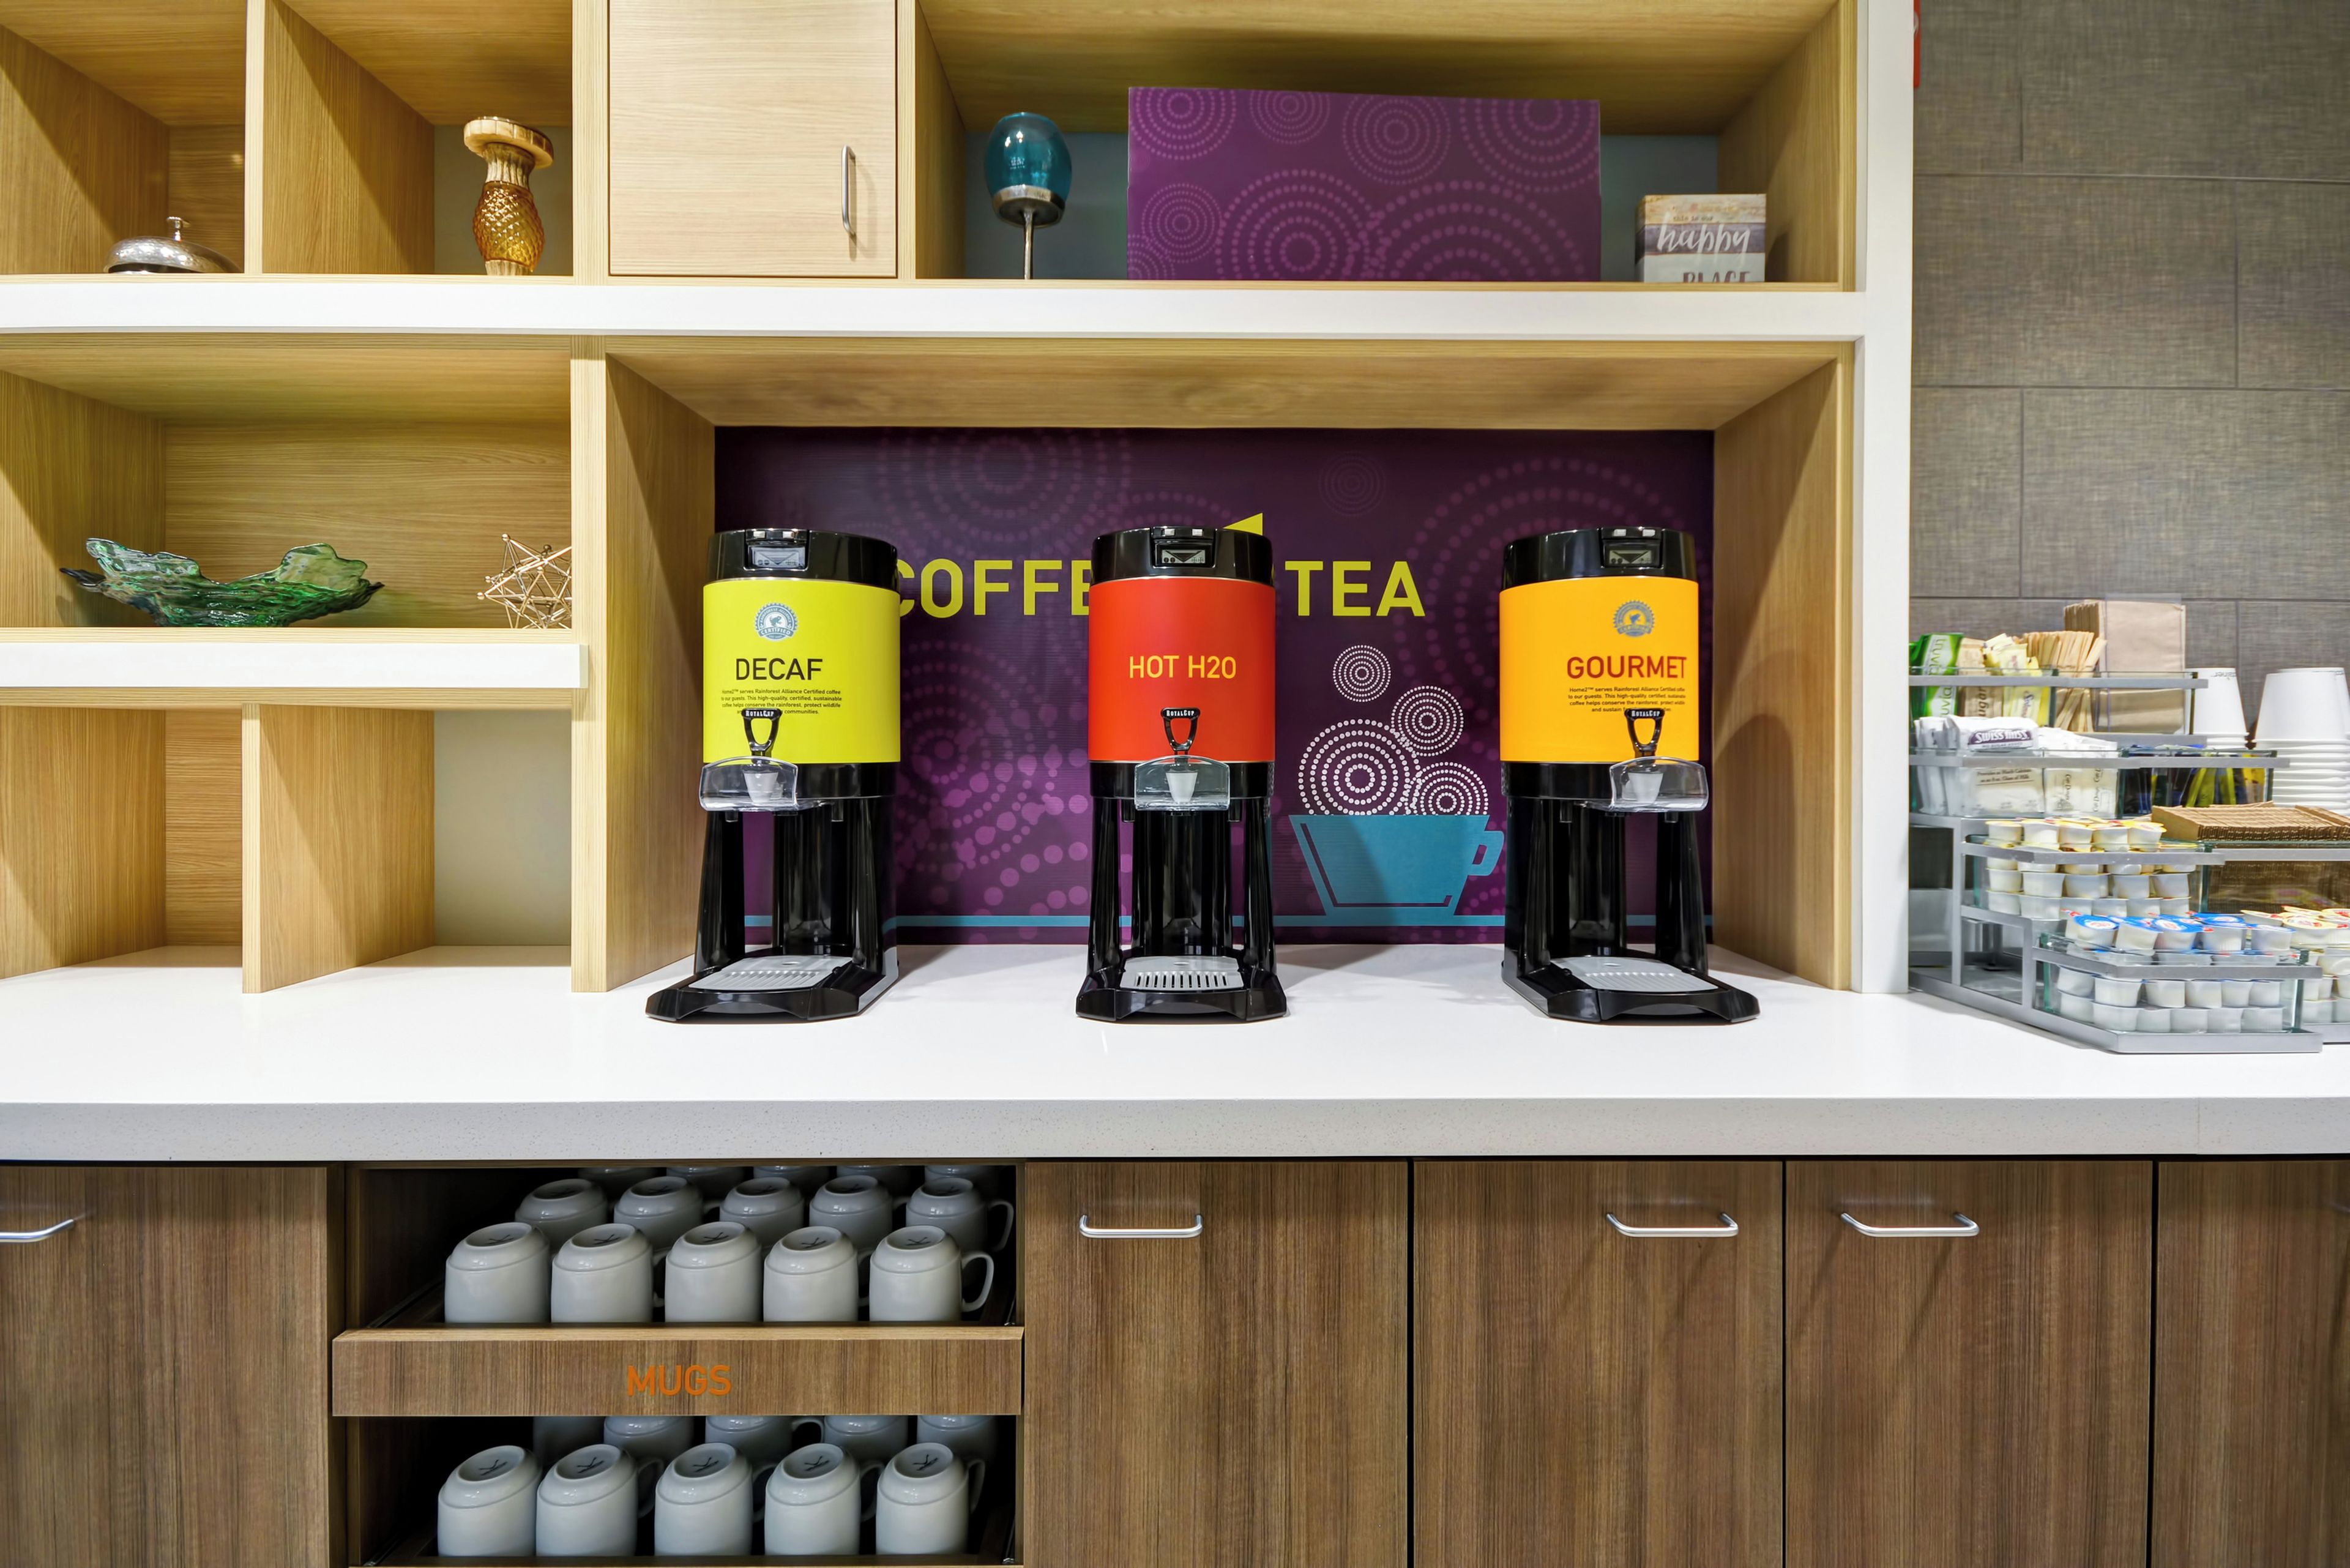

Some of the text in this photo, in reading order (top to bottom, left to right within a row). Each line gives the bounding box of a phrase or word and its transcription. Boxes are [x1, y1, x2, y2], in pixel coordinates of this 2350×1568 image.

[1657, 212, 1751, 268] happy
[897, 558, 1425, 618] OFFE TEA
[736, 657, 822, 681] DECAF
[1129, 655, 1179, 679] HOT
[1567, 655, 1687, 679] GOURMET
[1978, 687, 1989, 717] ugar
[627, 1365, 732, 1396] MUGS
